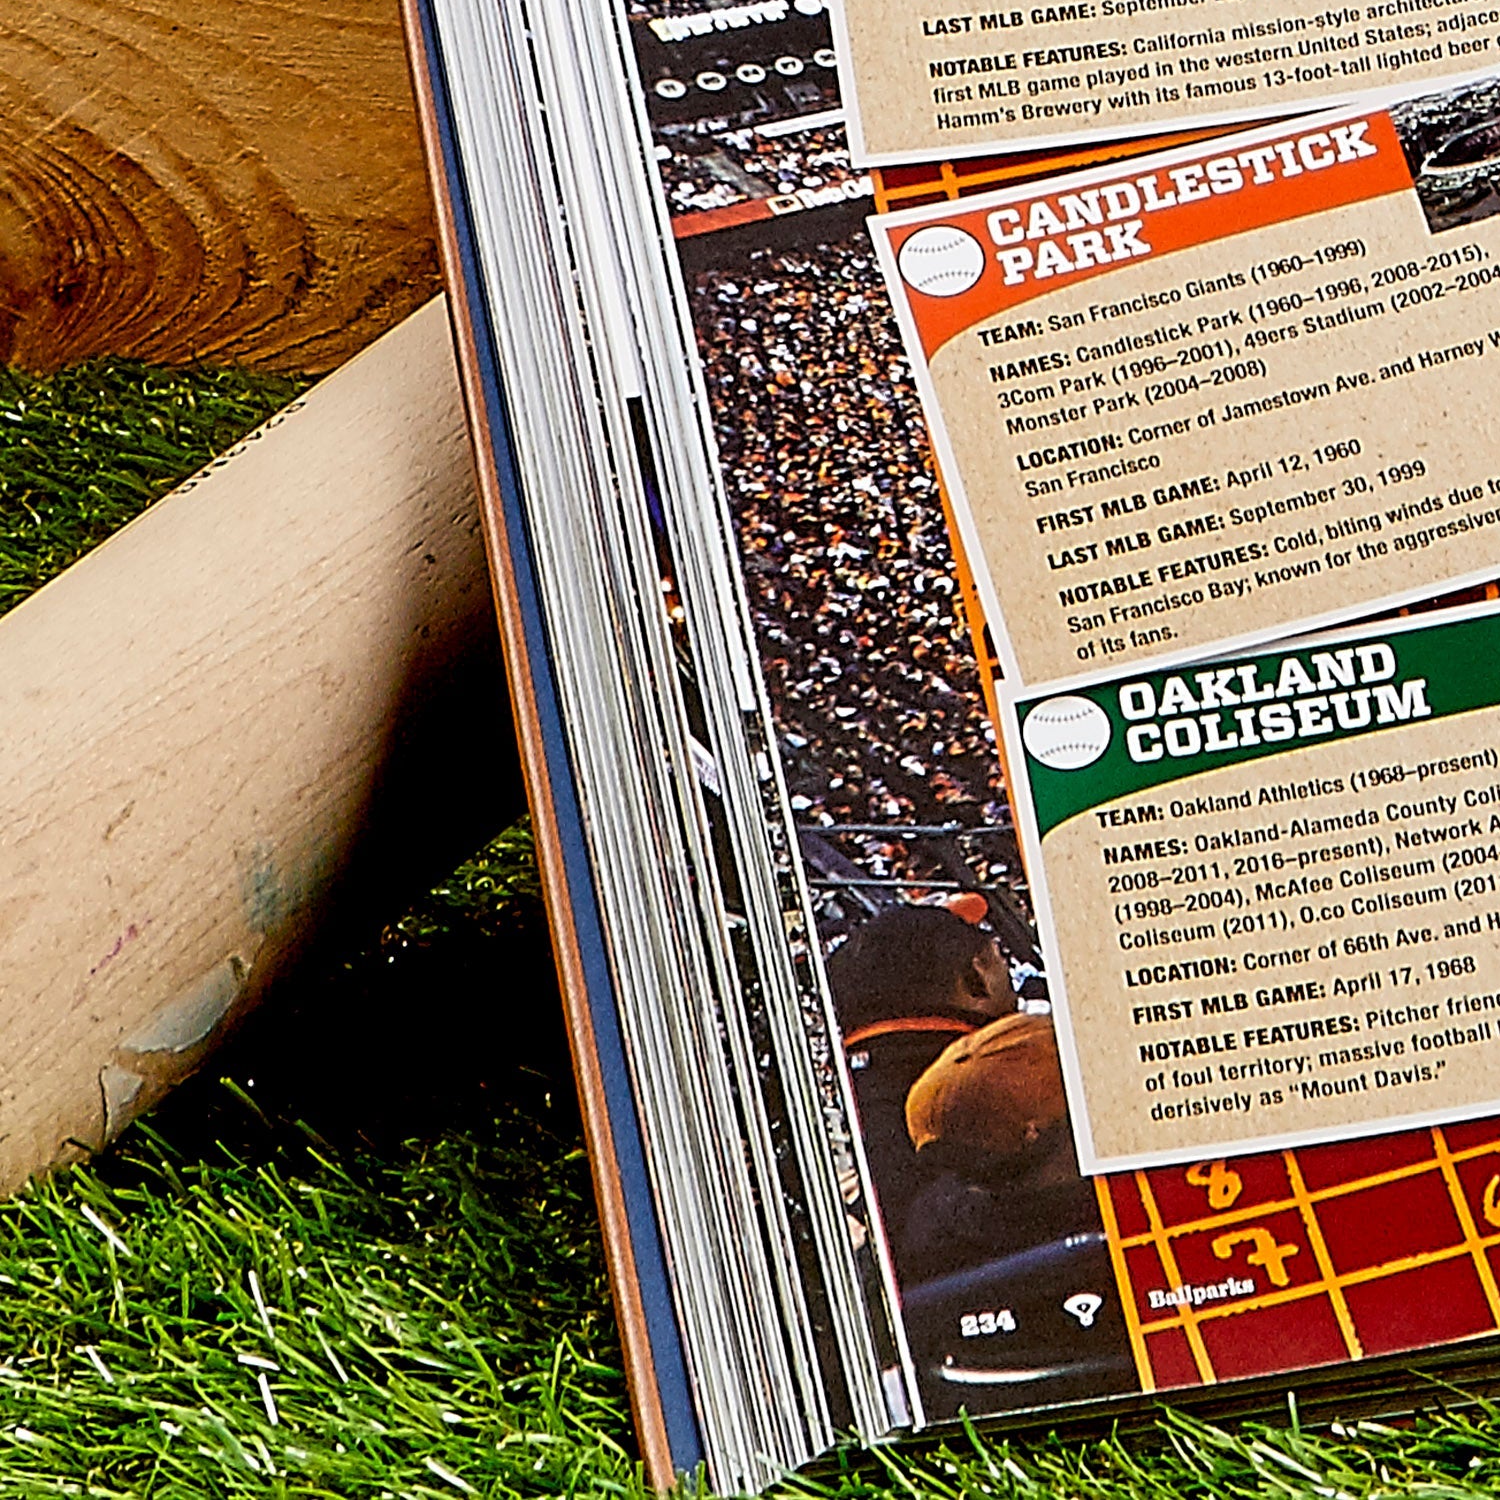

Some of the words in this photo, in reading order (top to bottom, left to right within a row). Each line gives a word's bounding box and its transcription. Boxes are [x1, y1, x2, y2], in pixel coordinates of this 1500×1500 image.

[922, 16, 973, 37] LAST
[979, 11, 1024, 31] MLB
[1030, 2, 1097, 25] GAME:
[987, 120, 1379, 246] CANDLESTICK
[995, 217, 1151, 287] PARK
[976, 320, 1044, 347] TEAM:
[1047, 312, 1086, 332] San
[1088, 289, 1182, 323] Francisco
[1185, 272, 1247, 299] Giants
[1016, 433, 1124, 472] LOCATION:
[1127, 418, 1191, 445] Corner
[1196, 408, 1216, 428] of
[1221, 382, 1331, 423] Jamestown
[1335, 372, 1376, 393] Ave.
[1378, 355, 1416, 381] and
[1417, 339, 1484, 369] Harney
[1024, 478, 1064, 498] San
[1065, 454, 1161, 489] Francisco
[1035, 505, 1094, 535] FIRST
[1100, 493, 1148, 519] MLB
[1152, 476, 1221, 506] GAME:
[1227, 461, 1274, 489] April
[1277, 454, 1310, 474] 12,
[1312, 438, 1362, 465] 1960
[1046, 542, 1099, 571] LAST
[1104, 531, 1152, 557] MLB
[1156, 514, 1226, 544] GAME:
[1228, 486, 1337, 526] September
[1341, 476, 1374, 497] 30,
[1376, 459, 1426, 487] 1999
[1076, 640, 1096, 661] of
[1099, 637, 1127, 655] its
[1129, 626, 1179, 648] fans.
[1119, 643, 1397, 721] OAKLAND
[1125, 681, 1432, 763] COLISEUM
[1095, 804, 1165, 829] TEAM:
[1169, 789, 1253, 819] Oakland
[1258, 778, 1345, 806] Athletics
[1125, 956, 1238, 988] LOCATION:
[1243, 947, 1311, 971] Corner
[1317, 939, 1338, 960] of
[1342, 932, 1390, 956] 66th
[1396, 928, 1439, 948] Ave.
[1443, 915, 1482, 939] and
[1132, 1000, 1194, 1026] FIRST
[1200, 992, 1249, 1016] MLB
[1255, 981, 1327, 1008] GAME:
[1333, 971, 1382, 998] April
[1389, 966, 1421, 987] 17,
[1426, 955, 1477, 981] 1968
[960, 1309, 1016, 1335] 234
[1147, 1275, 1255, 1312] Ballparks
